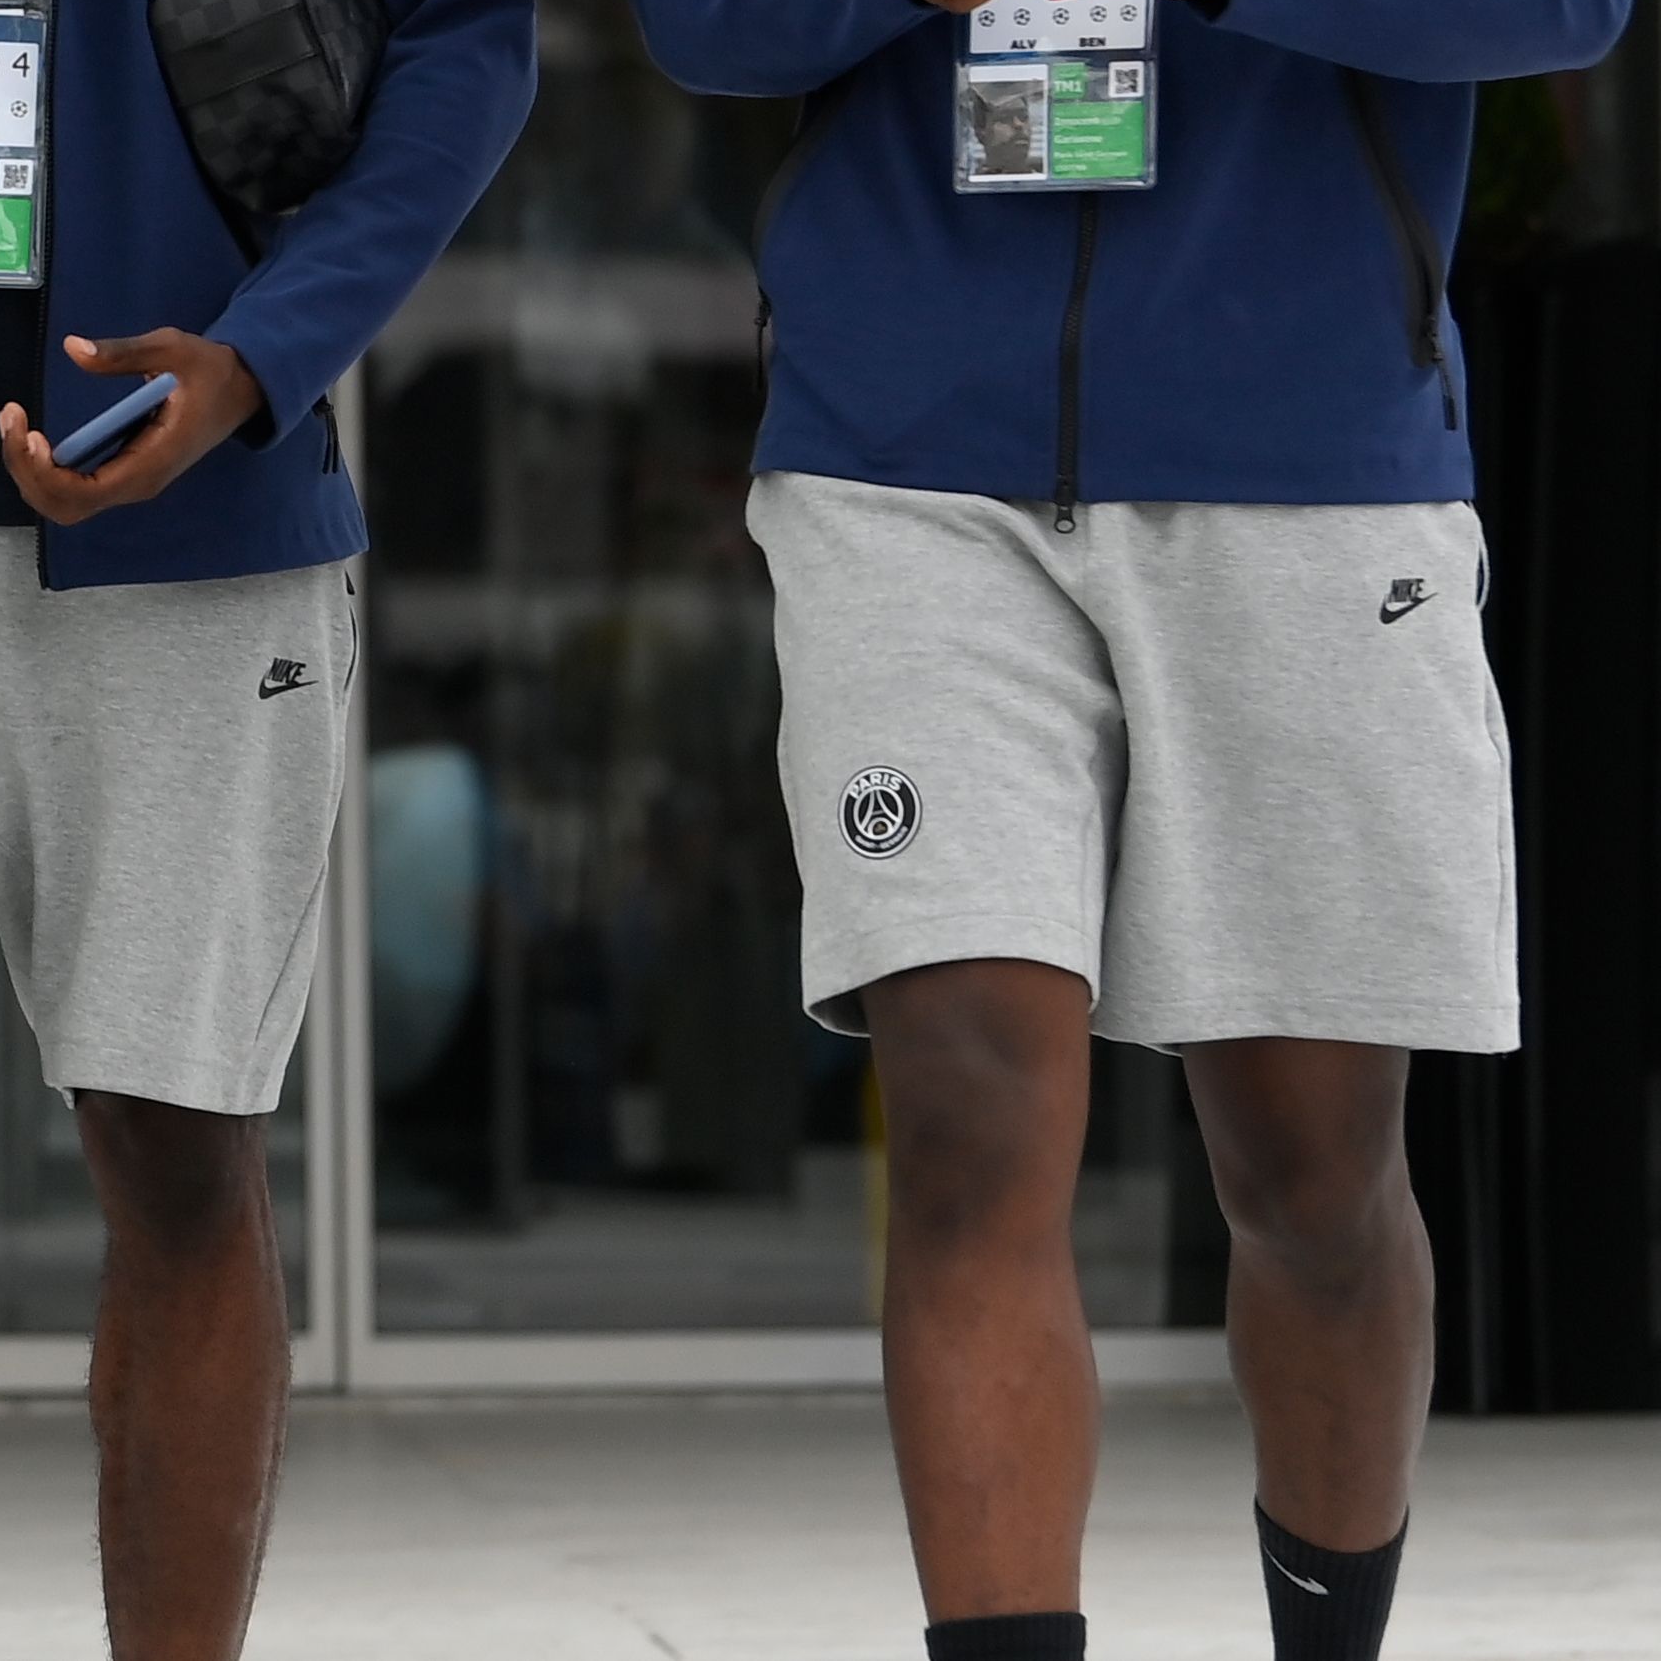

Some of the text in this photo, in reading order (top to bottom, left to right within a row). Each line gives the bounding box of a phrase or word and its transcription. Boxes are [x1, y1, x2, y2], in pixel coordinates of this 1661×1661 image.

[1011, 37, 1106, 50] ALV BEN
[12, 52, 30, 78] 4
[849, 772, 903, 799] PARIS
